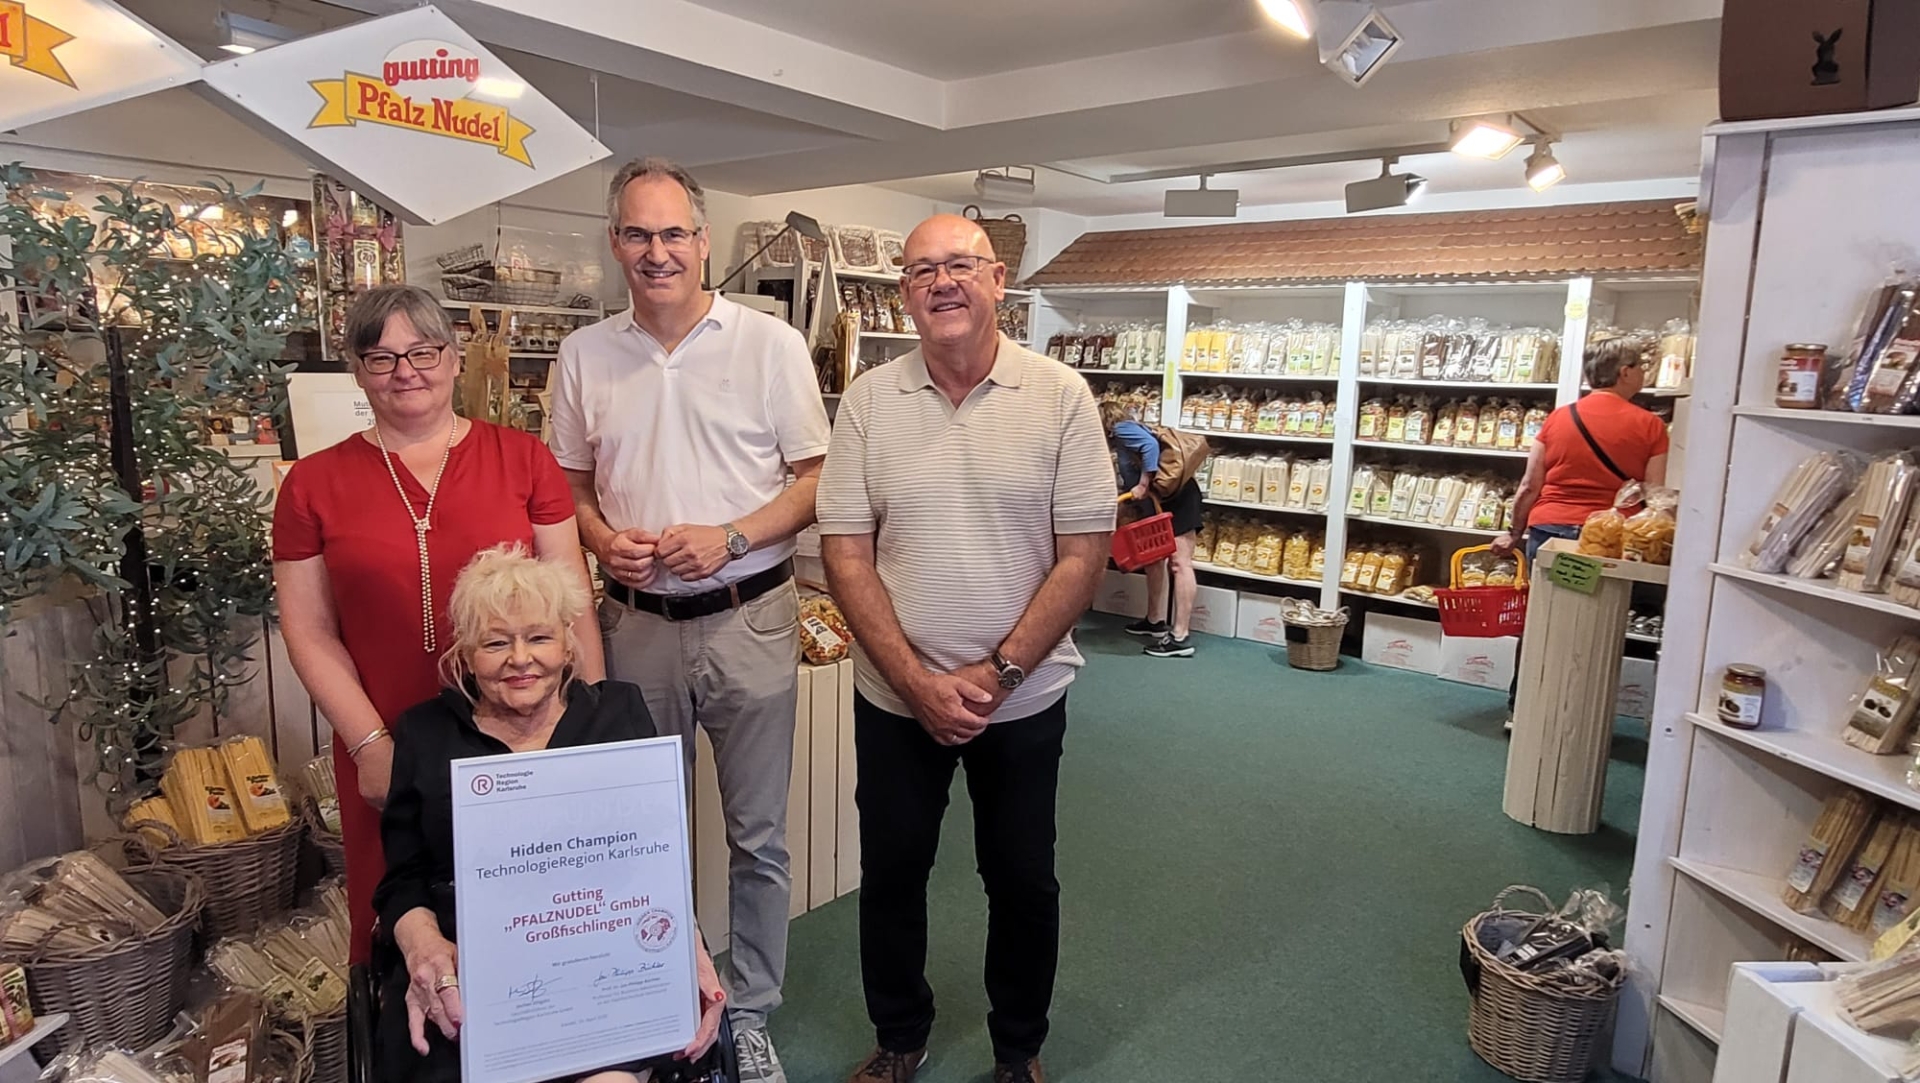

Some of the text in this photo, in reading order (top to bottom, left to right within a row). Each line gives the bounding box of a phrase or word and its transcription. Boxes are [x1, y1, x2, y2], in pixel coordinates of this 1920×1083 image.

[383, 49, 480, 86] gutting
[357, 80, 501, 142] Pfalz Nudel
[495, 770, 534, 779] Technologie
[510, 830, 638, 858] Hidden Champion
[476, 841, 670, 880] TechnologieRegion Karlsruhe
[552, 888, 604, 905] Gutting
[610, 895, 650, 912] GmbH
[525, 915, 632, 943] Großfischlingen
